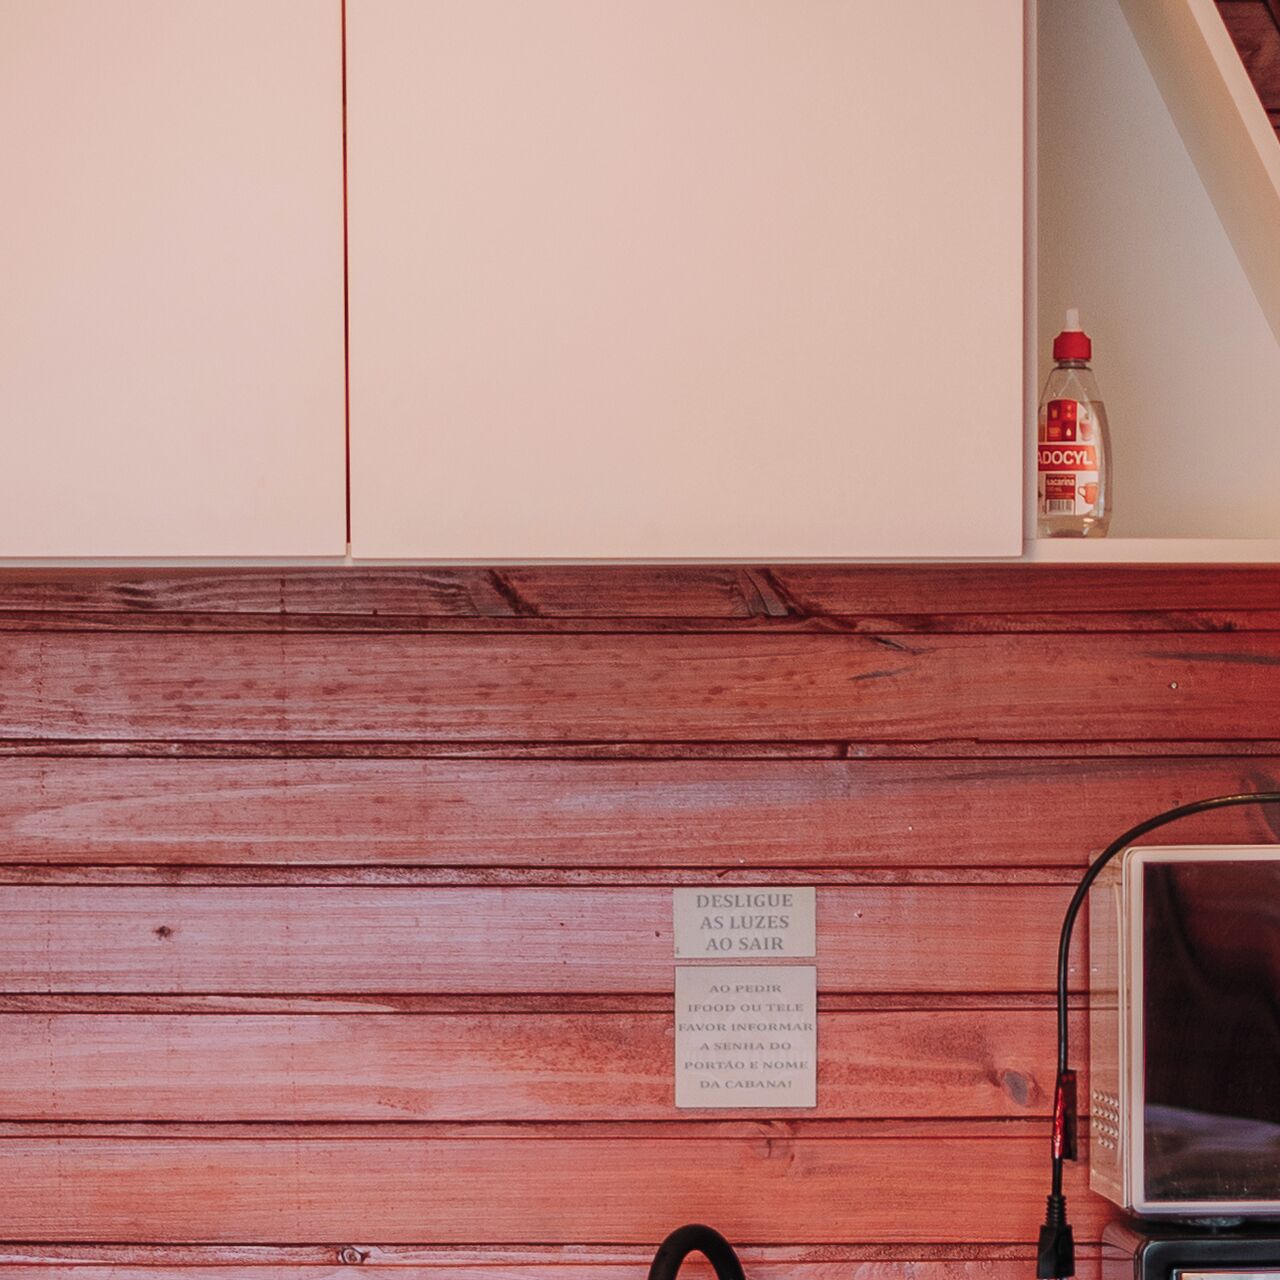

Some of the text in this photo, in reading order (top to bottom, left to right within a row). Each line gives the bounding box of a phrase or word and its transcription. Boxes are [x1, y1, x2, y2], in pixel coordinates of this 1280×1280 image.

[696, 893, 793, 909] DESLIGUE
[700, 915, 790, 930] AS LUZES
[705, 936, 785, 951] AO SAIR
[709, 984, 782, 993] AO PEDIR
[688, 1003, 804, 1013] IFOOD OU TELE
[678, 1022, 813, 1032] FAVOR INFORMAR
[700, 1042, 792, 1051] A SENHA DO
[684, 1060, 809, 1070] PORTÃO E NOME
[700, 1080, 793, 1089] DA CABANA!
